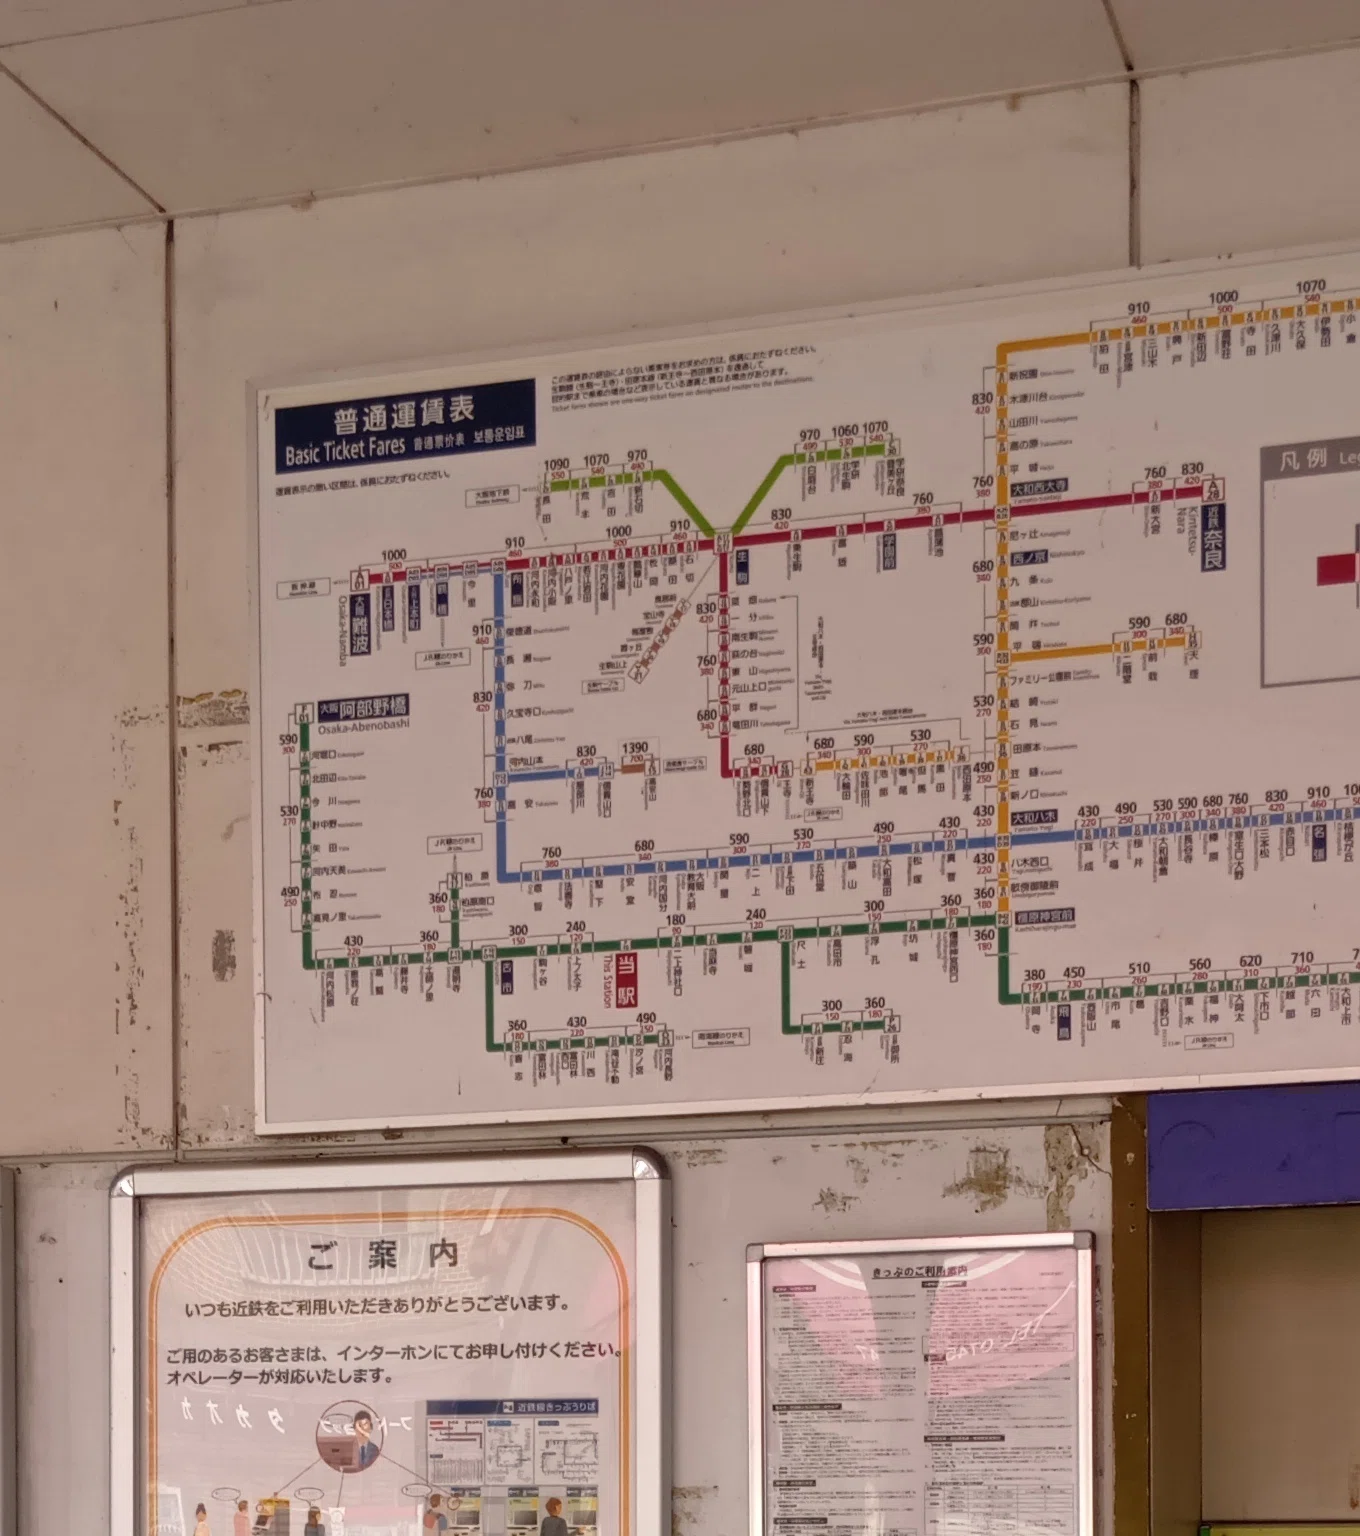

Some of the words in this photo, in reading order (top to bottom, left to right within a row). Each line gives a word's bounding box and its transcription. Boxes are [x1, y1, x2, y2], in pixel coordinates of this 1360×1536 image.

[334, 395, 475, 435] 普通運賃表
[286, 442, 320, 466] Basic
[324, 439, 365, 461] Ticket
[369, 436, 406, 457] Fares
[1280, 448, 1328, 471] 凡例
[544, 458, 570, 469] 1090
[913, 493, 934, 504] 760
[1204, 506, 1224, 569] 近鉄奈良
[381, 549, 406, 561] 1000
[320, 696, 407, 721] 大阪阿部野橋
[318, 718, 410, 735] Osaka-Abenobashi
[666, 914, 686, 926] 180
[604, 954, 612, 972] This
[618, 955, 636, 1005] 当駅
[307, 1239, 460, 1269] ご案内
[185, 1294, 569, 1317] いつも近鉄をご利用いただきありがとうございます。
[167, 1341, 622, 1364] ご用のあるお客さまは、インターホンにてお申し付けください。
[167, 1368, 394, 1385] オペレーターが対応いたします。
